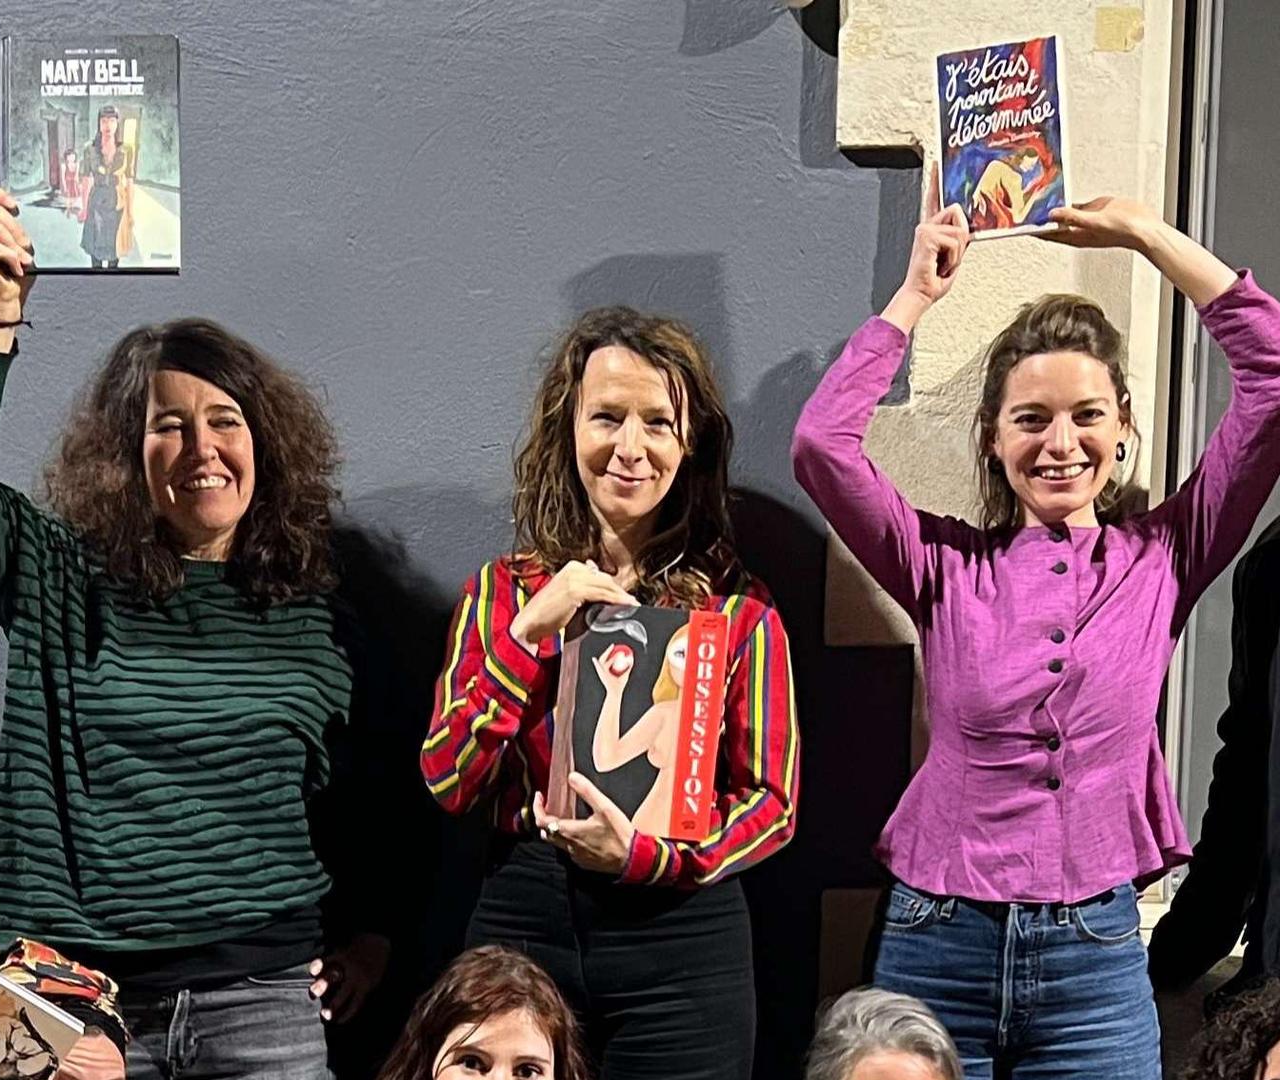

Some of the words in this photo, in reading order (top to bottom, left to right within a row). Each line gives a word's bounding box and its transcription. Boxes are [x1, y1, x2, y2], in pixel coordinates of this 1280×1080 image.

[41, 59, 91, 83] MARY
[95, 59, 144, 82] BELL
[949, 68, 1039, 129] pourtant
[949, 90, 1055, 147] déterminée
[682, 642, 715, 815] OBSESSION
